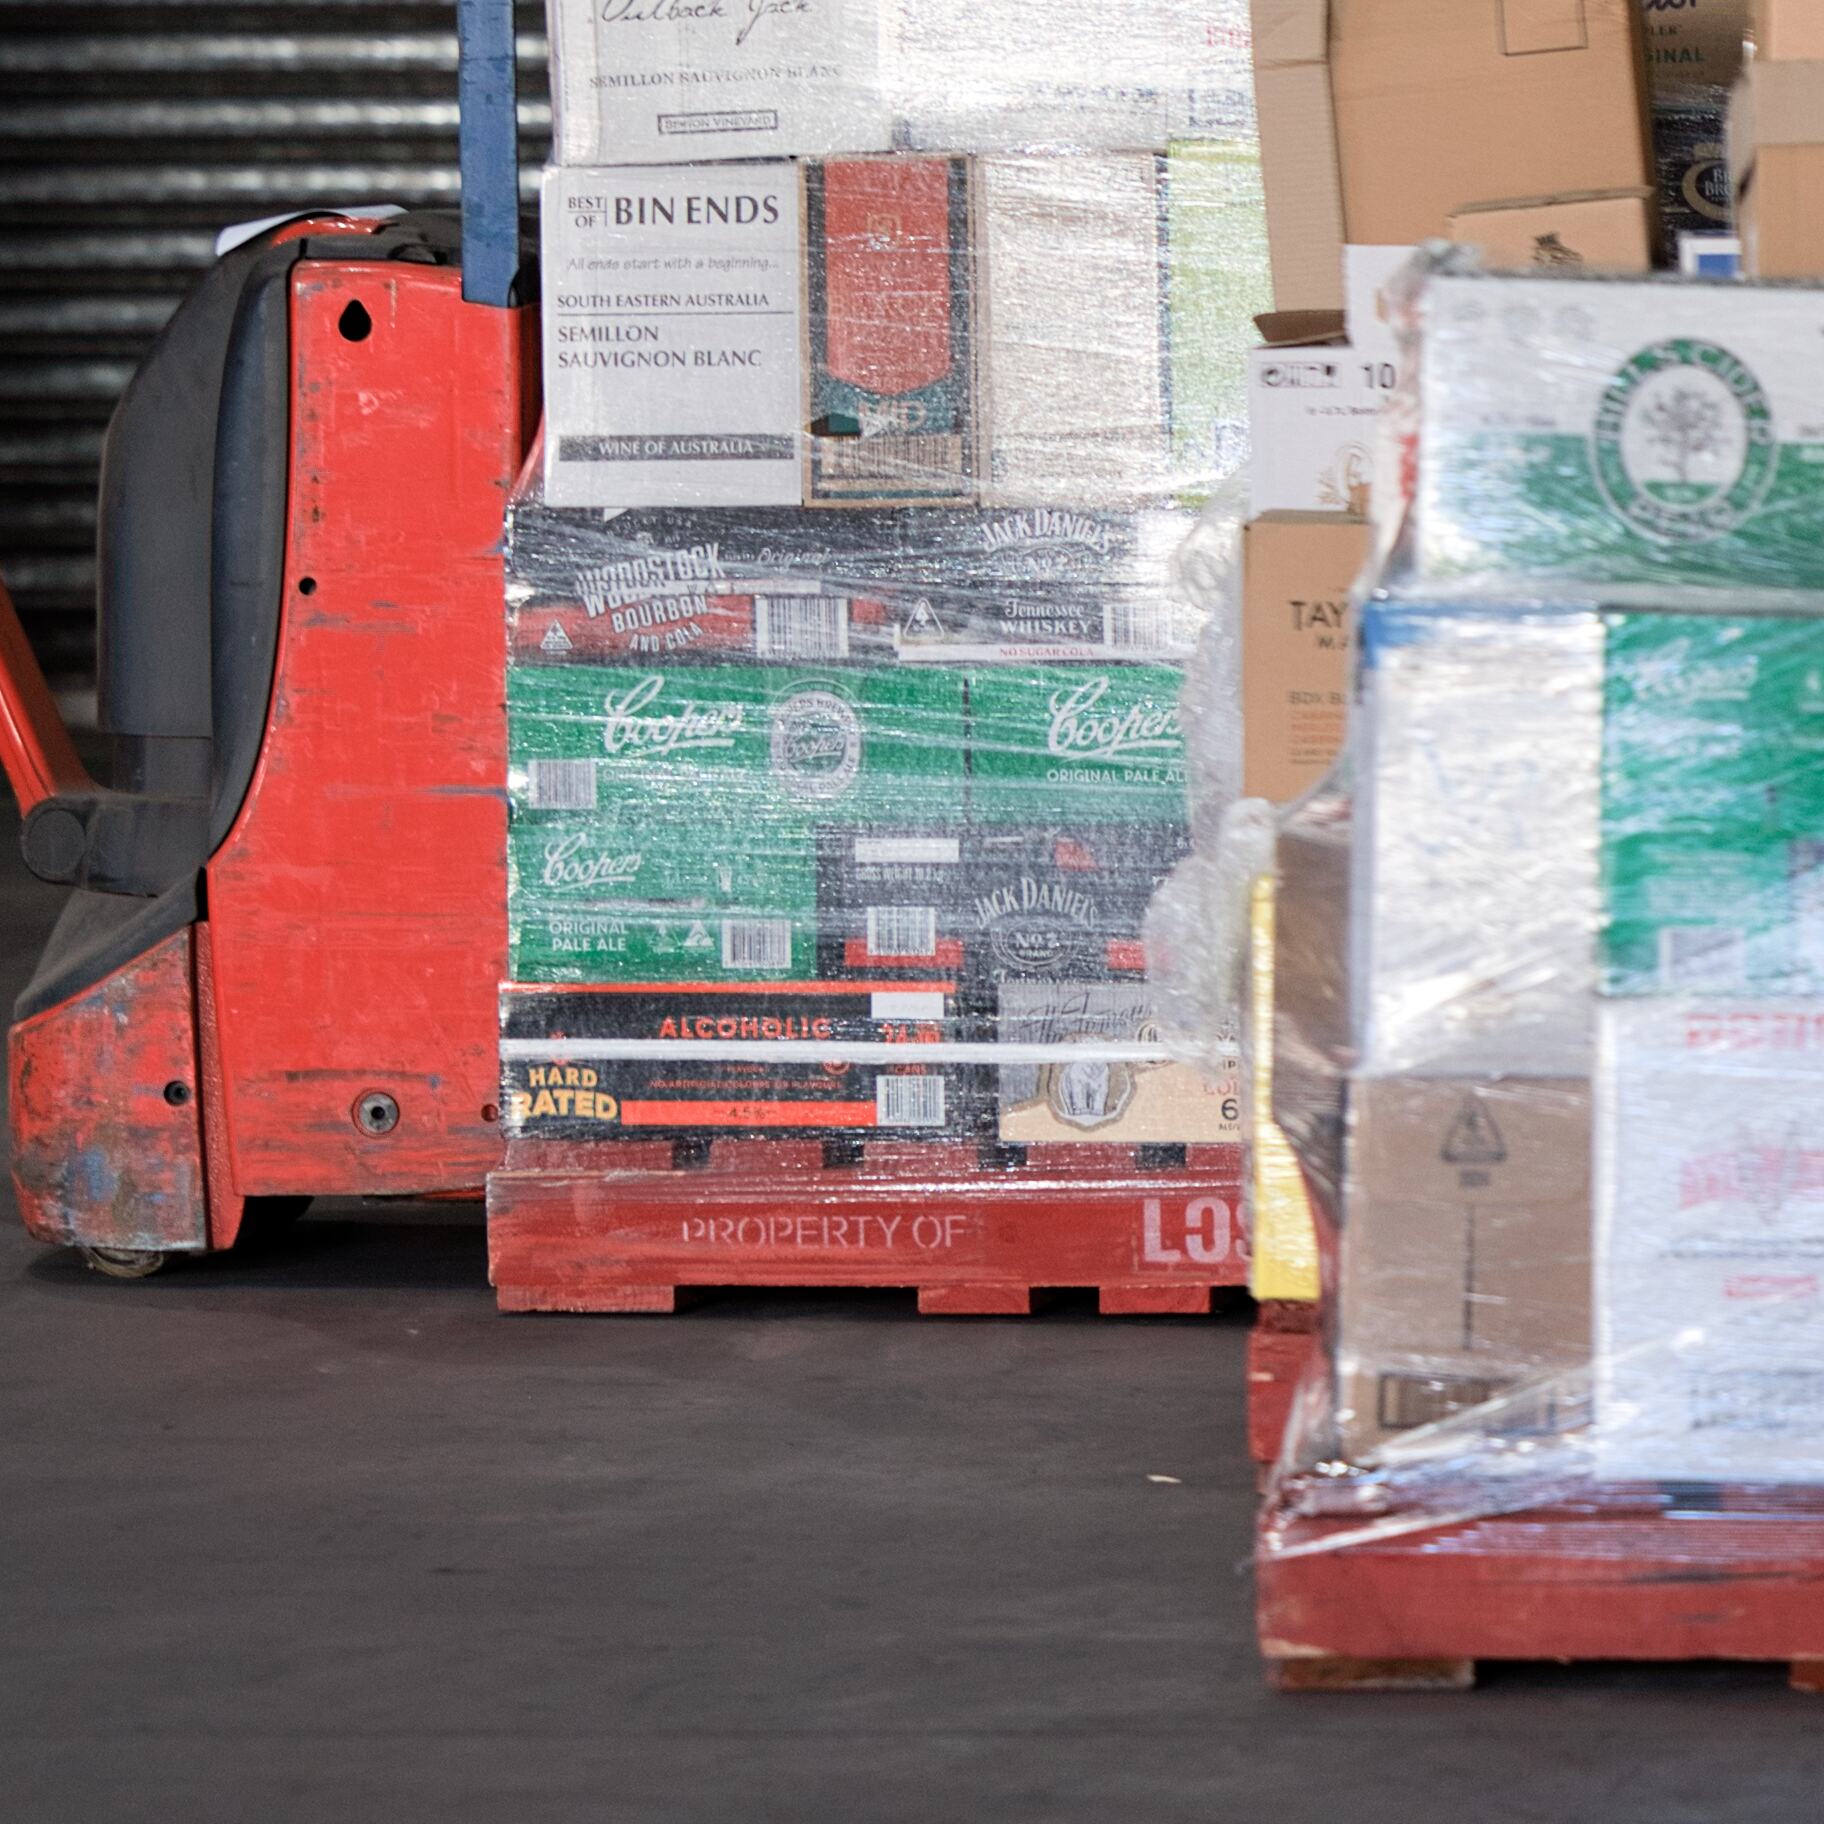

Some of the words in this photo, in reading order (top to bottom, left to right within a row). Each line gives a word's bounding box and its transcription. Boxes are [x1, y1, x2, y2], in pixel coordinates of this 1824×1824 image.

[589, 74, 675, 89] SEMILLON
[679, 69, 782, 84] SAUVIGNON
[567, 196, 604, 210] BEST
[614, 196, 676, 225] BIN
[686, 194, 779, 225] ENDS
[574, 214, 597, 229] OF
[567, 258, 585, 271] All
[587, 258, 619, 271] ends
[622, 257, 661, 270] start
[663, 257, 692, 270] with
[557, 294, 611, 308] SOUTH
[615, 293, 681, 308] EASTERN
[685, 293, 770, 307] AUSTRALIA
[557, 326, 659, 343] SEMILLON
[558, 350, 687, 368] SAUVIGNON
[693, 349, 763, 367] BLANC
[1363, 362, 1397, 389] 10
[598, 440, 641, 456] WINE
[643, 440, 667, 456] OF
[670, 439, 755, 457] AUSTRALIA
[981, 513, 1033, 553] JACK
[610, 594, 709, 634] BOURBON
[1003, 599, 1085, 618] Tennessee
[999, 619, 1092, 634] WHISKEY
[629, 633, 660, 652] AND
[664, 622, 704, 651] COLA
[1000, 647, 1018, 658] NO
[1021, 646, 1061, 658] SUGAR
[1063, 646, 1095, 658] COLA
[603, 675, 746, 756] Coopers
[1047, 676, 1182, 756] Coopers
[1046, 769, 1119, 783] ORIGINAL
[1125, 769, 1162, 783] PALE
[543, 831, 643, 891] Coopers
[974, 885, 1020, 930] JACK
[549, 919, 628, 935] ORIGINAL
[552, 937, 592, 951] PALE
[596, 937, 627, 951] ALE
[658, 1015, 832, 1040] ALCOHOLIC
[528, 1067, 599, 1089] HARD
[510, 1089, 619, 1121] RATED
[681, 1215, 897, 1250] PROPERTY
[912, 1214, 968, 1249] OF
